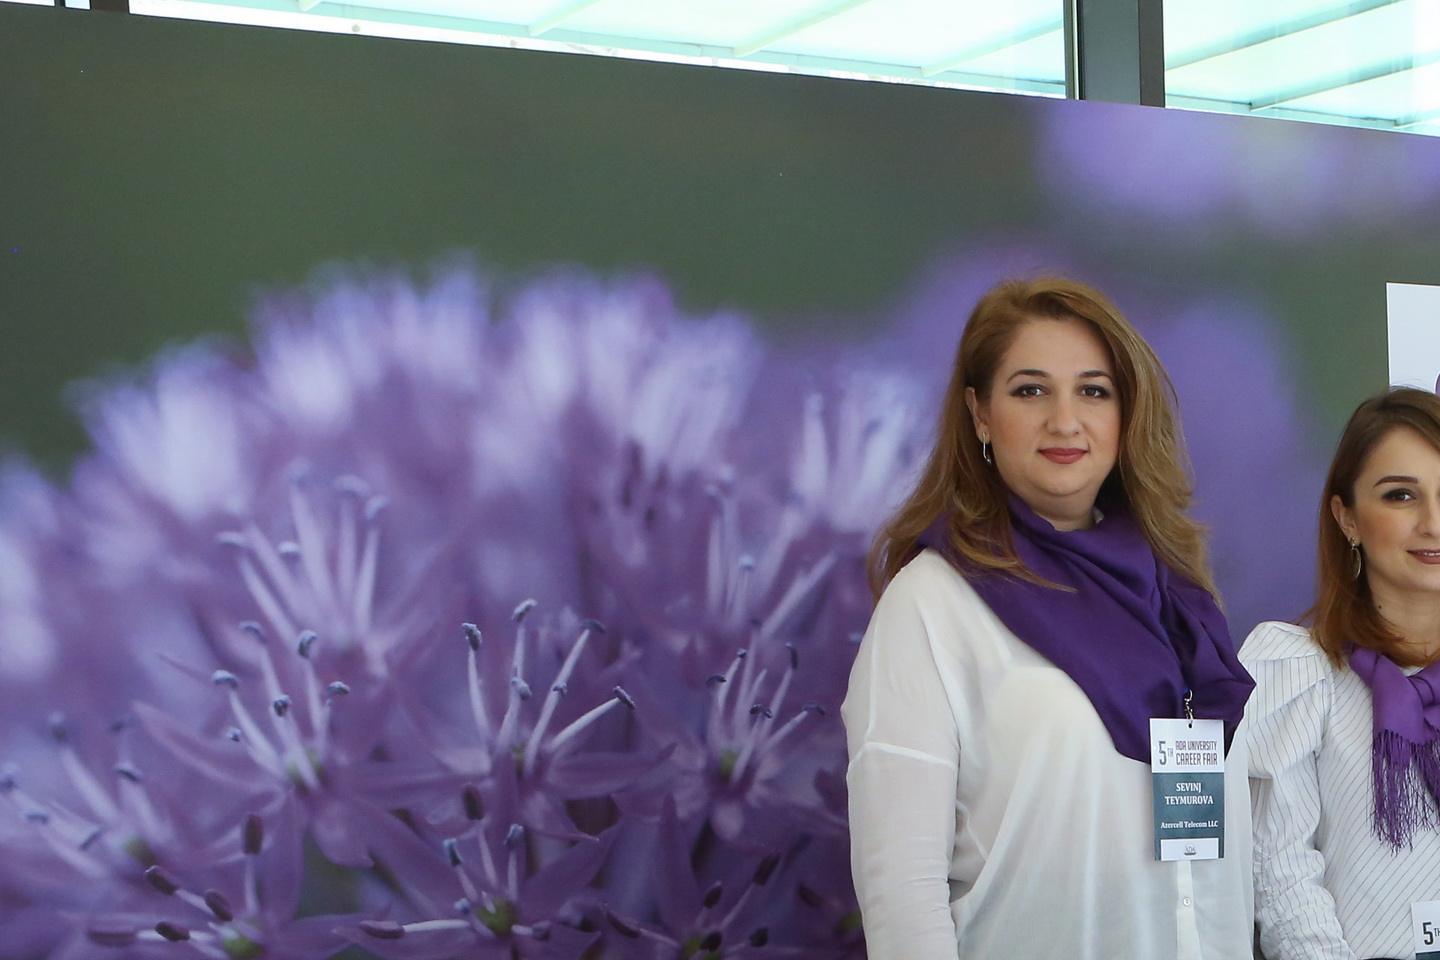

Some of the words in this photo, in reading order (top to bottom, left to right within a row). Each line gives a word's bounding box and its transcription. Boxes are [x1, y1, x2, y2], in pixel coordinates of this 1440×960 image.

[1188, 741, 1217, 751] UNIVERSITY
[1176, 753, 1201, 766] CAREER
[1203, 753, 1218, 766] FAIR
[1176, 782, 1202, 793] SEVINJ
[1165, 795, 1213, 805] TEYMUROVA
[1161, 821, 1183, 829] Azercell
[1208, 820, 1218, 828] LLC
